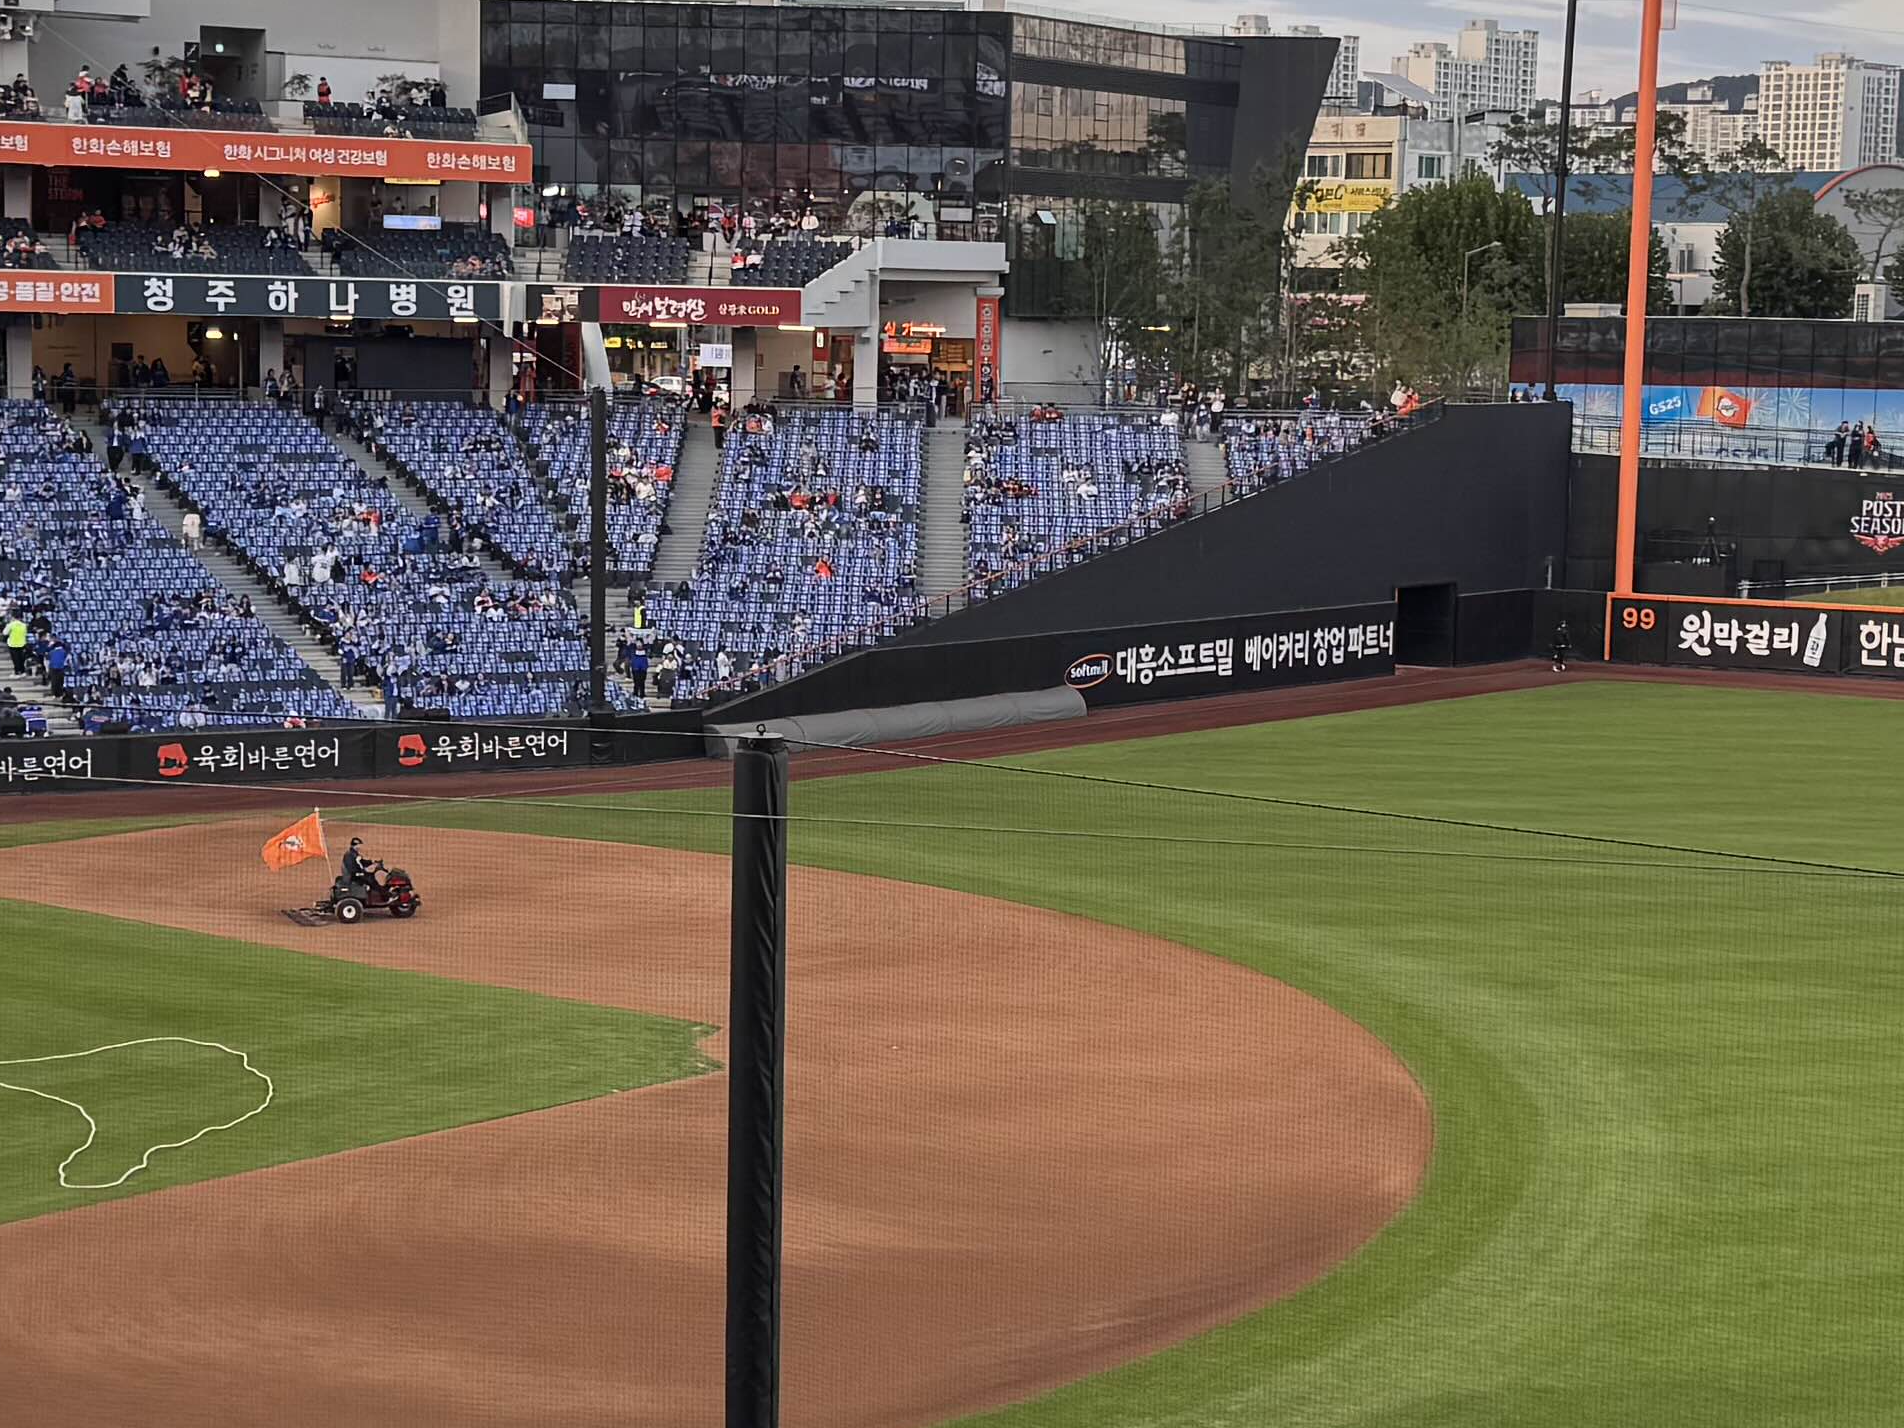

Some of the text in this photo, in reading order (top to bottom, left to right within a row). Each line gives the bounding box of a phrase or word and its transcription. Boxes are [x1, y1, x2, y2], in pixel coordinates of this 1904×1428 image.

[72, 137, 171, 159] 한화손해보험
[224, 143, 517, 172] 한화 시그니처 여성 건강보험 한화손해보험
[1649, 396, 1682, 416] GS25
[1862, 500, 1904, 517] POST
[1623, 607, 1656, 631] 99
[1116, 621, 1394, 685] 대흥소프트밀 베이커리 창업 파트너
[193, 737, 340, 773] 육회바른연어
[432, 731, 568, 764] 육회바른연어
